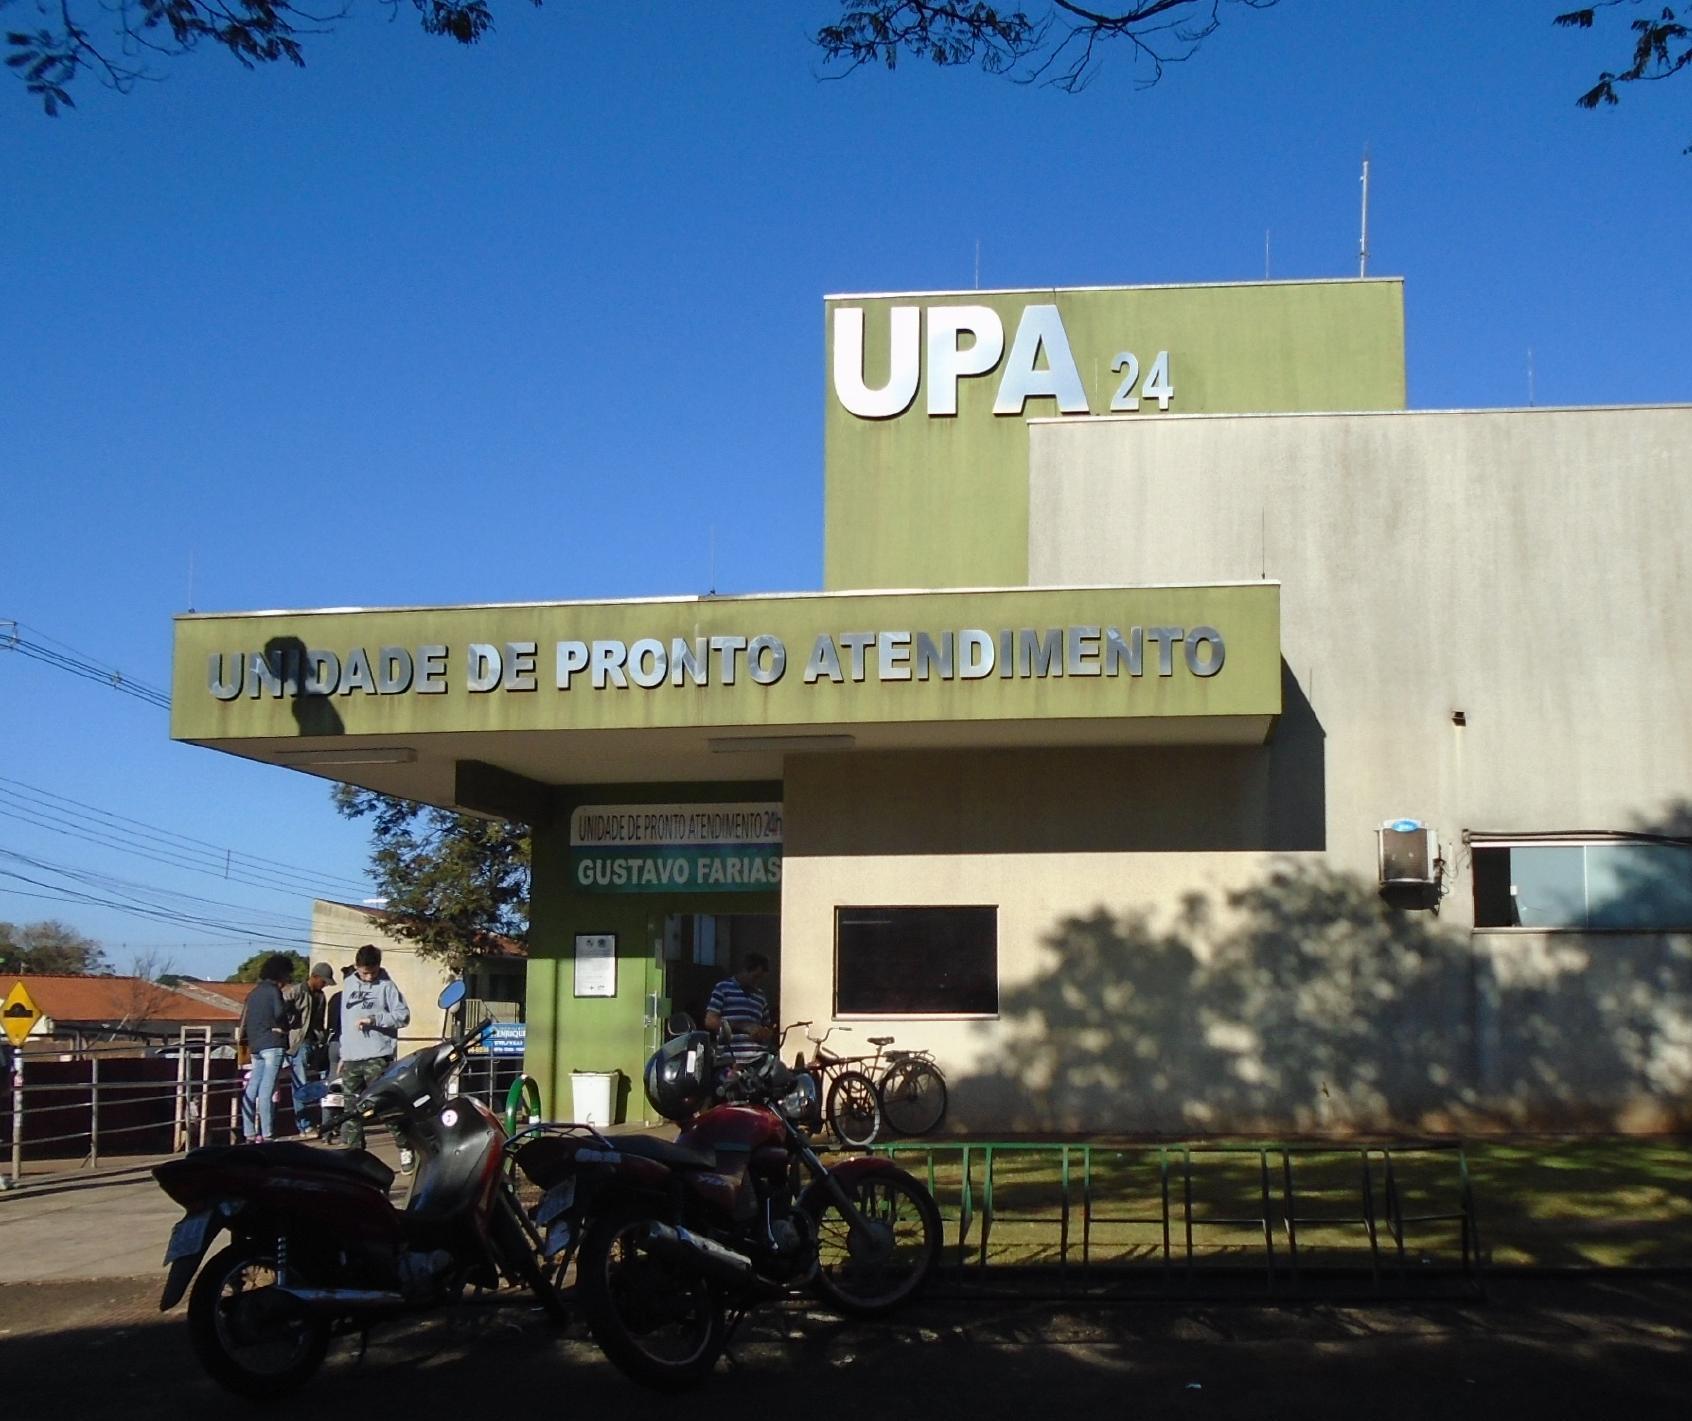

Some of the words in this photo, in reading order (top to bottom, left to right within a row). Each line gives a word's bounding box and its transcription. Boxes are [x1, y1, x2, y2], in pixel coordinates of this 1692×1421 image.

[833, 304, 1090, 418] UPA
[1110, 351, 1174, 411] 24
[208, 644, 448, 700] UNIDADE
[467, 642, 537, 693] DE
[556, 635, 786, 688] PRONTO
[803, 626, 1226, 682] ATENDIMENTO
[578, 815, 626, 841] UNIDADE
[628, 815, 642, 841] DE
[644, 814, 686, 841] PRONTO
[688, 812, 763, 840] ATENDIMENTO
[577, 857, 690, 885] GUSTAVO
[697, 856, 782, 883] FARIAS
